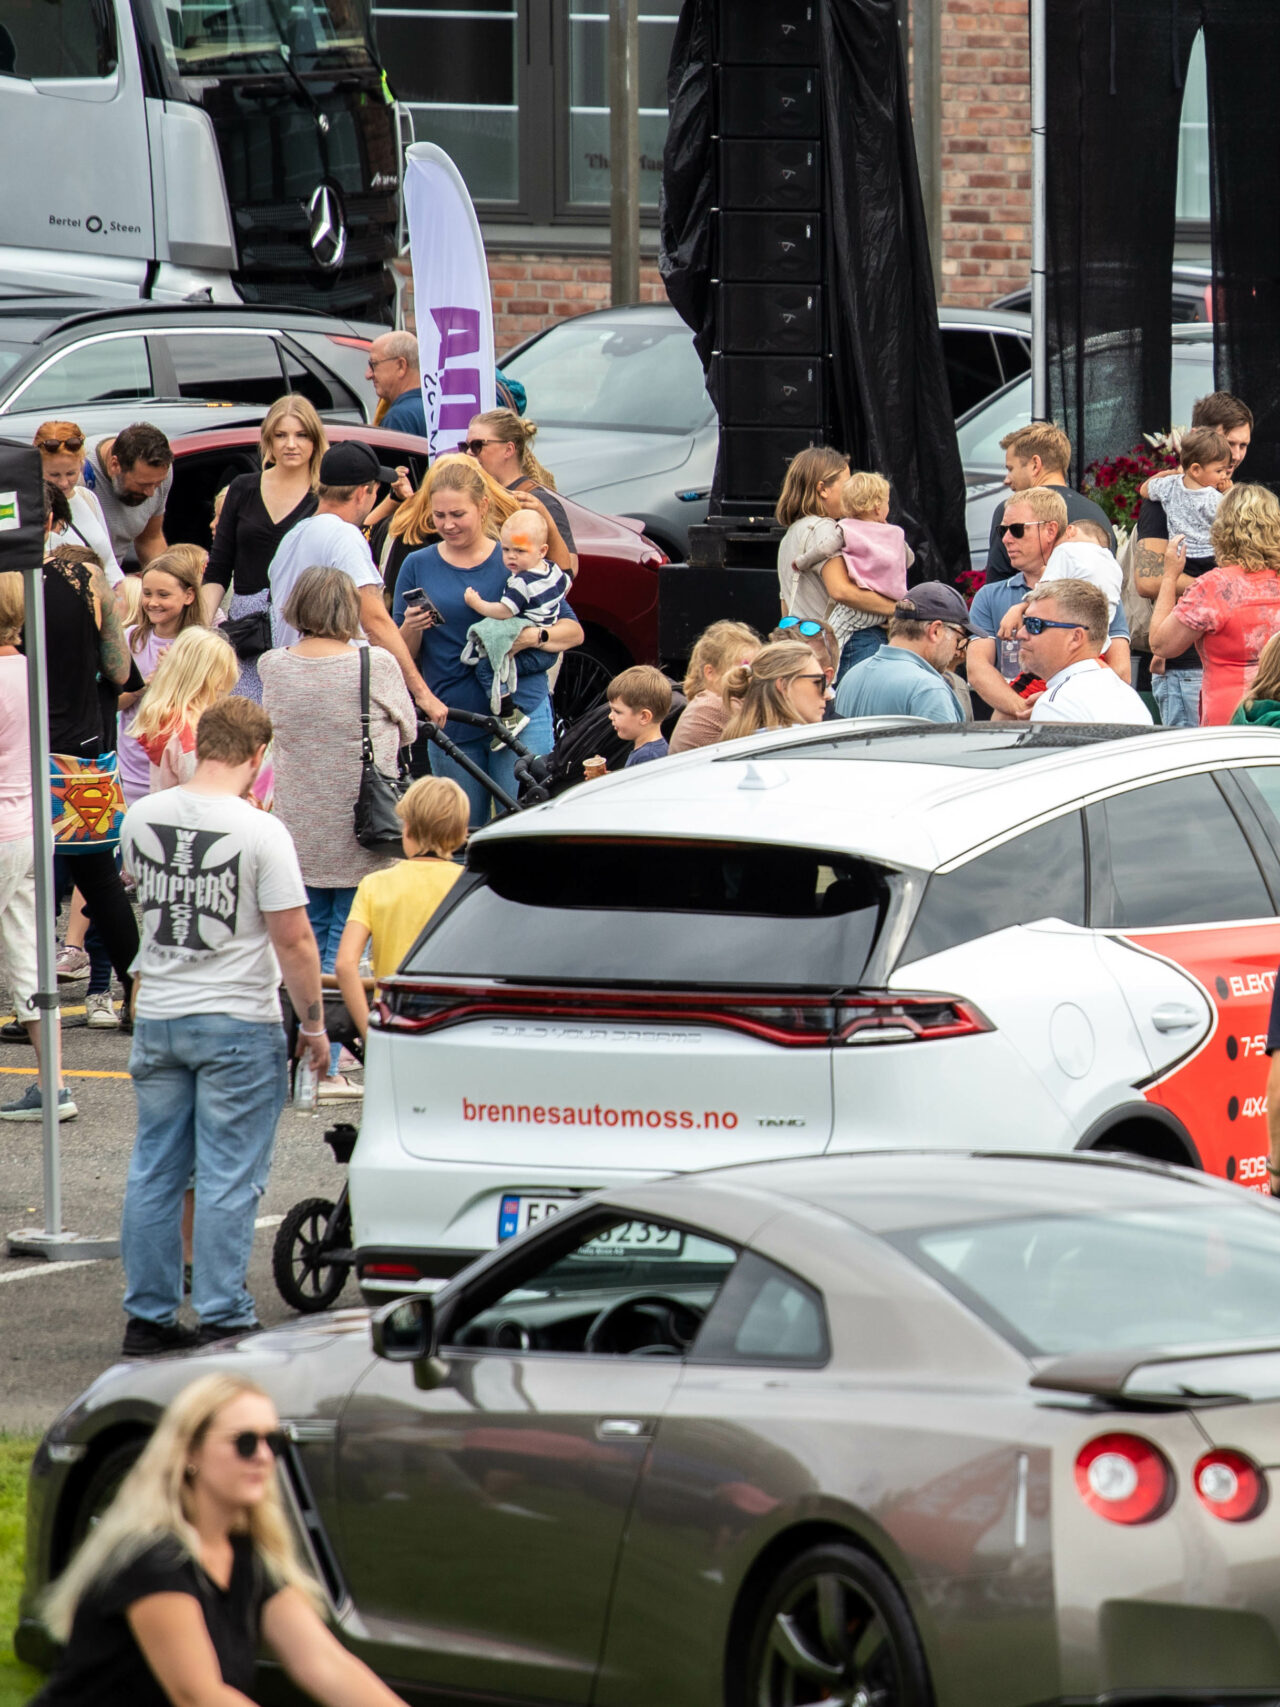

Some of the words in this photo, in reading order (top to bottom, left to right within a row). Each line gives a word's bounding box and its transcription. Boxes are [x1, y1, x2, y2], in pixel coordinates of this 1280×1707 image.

[48, 214, 81, 228] Bertel
[109, 220, 142, 233] Steen
[170, 828, 198, 876] WEST
[169, 903, 192, 946] COAST
[1230, 971, 1278, 997] ELEKT
[462, 1097, 738, 1130] brennesautomoss.no
[756, 1115, 806, 1128] TANG
